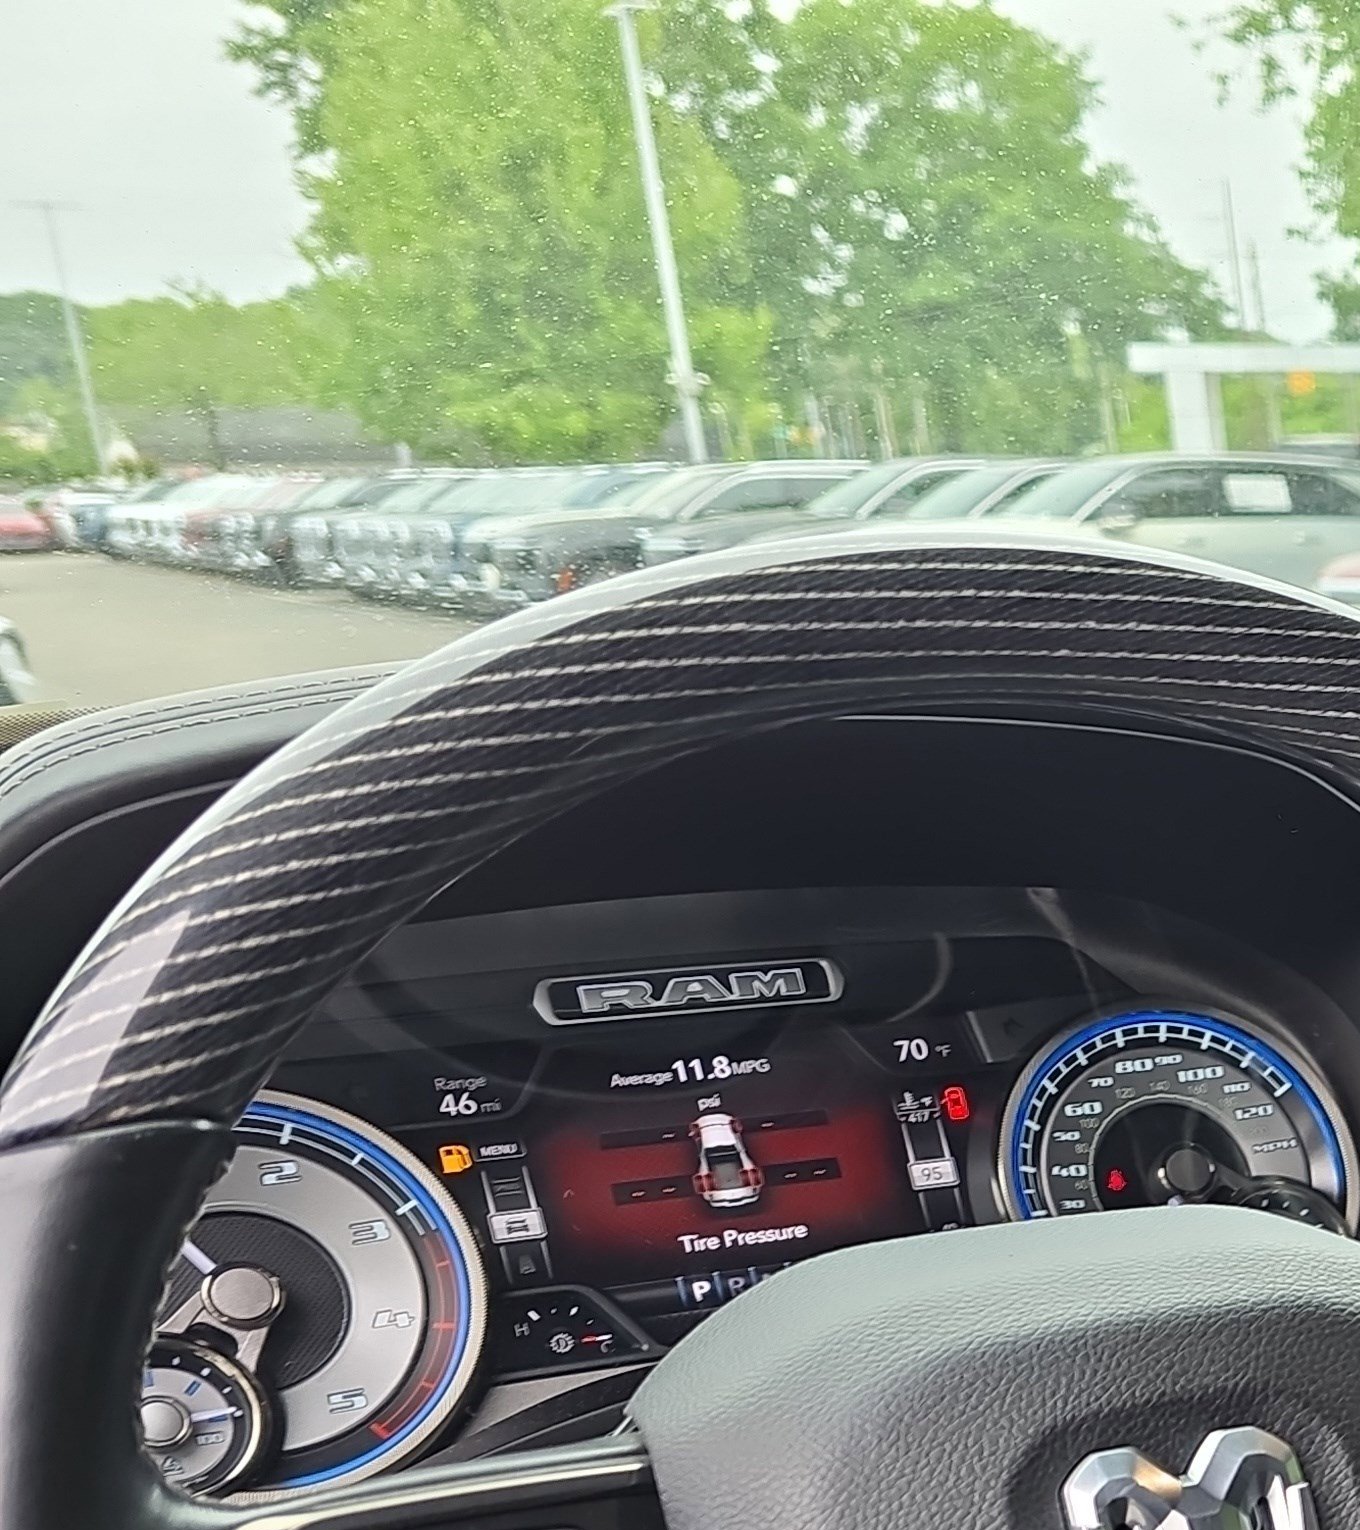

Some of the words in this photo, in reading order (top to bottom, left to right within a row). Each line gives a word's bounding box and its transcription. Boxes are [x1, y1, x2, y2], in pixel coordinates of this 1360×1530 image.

[577, 966, 806, 1014] RAM
[893, 1038, 930, 1064] 70
[1154, 1053, 1183, 1066] 90
[1115, 1057, 1154, 1074] 80
[1177, 1065, 1225, 1083] 100
[434, 1075, 487, 1093] Range
[610, 1069, 674, 1090] Average
[1088, 1076, 1114, 1088] 70
[438, 1092, 478, 1117] 46
[697, 1093, 722, 1112] psi
[1064, 1101, 1103, 1117] 60
[1233, 1104, 1274, 1121] 120
[258, 1160, 302, 1187] 2
[921, 1165, 943, 1182] 95
[1051, 1164, 1088, 1177] 40
[348, 1220, 391, 1246] 3
[677, 1233, 722, 1257] Tire
[724, 1221, 810, 1252] Pressure
[372, 1309, 415, 1329] 4
[327, 1387, 369, 1414] 5
